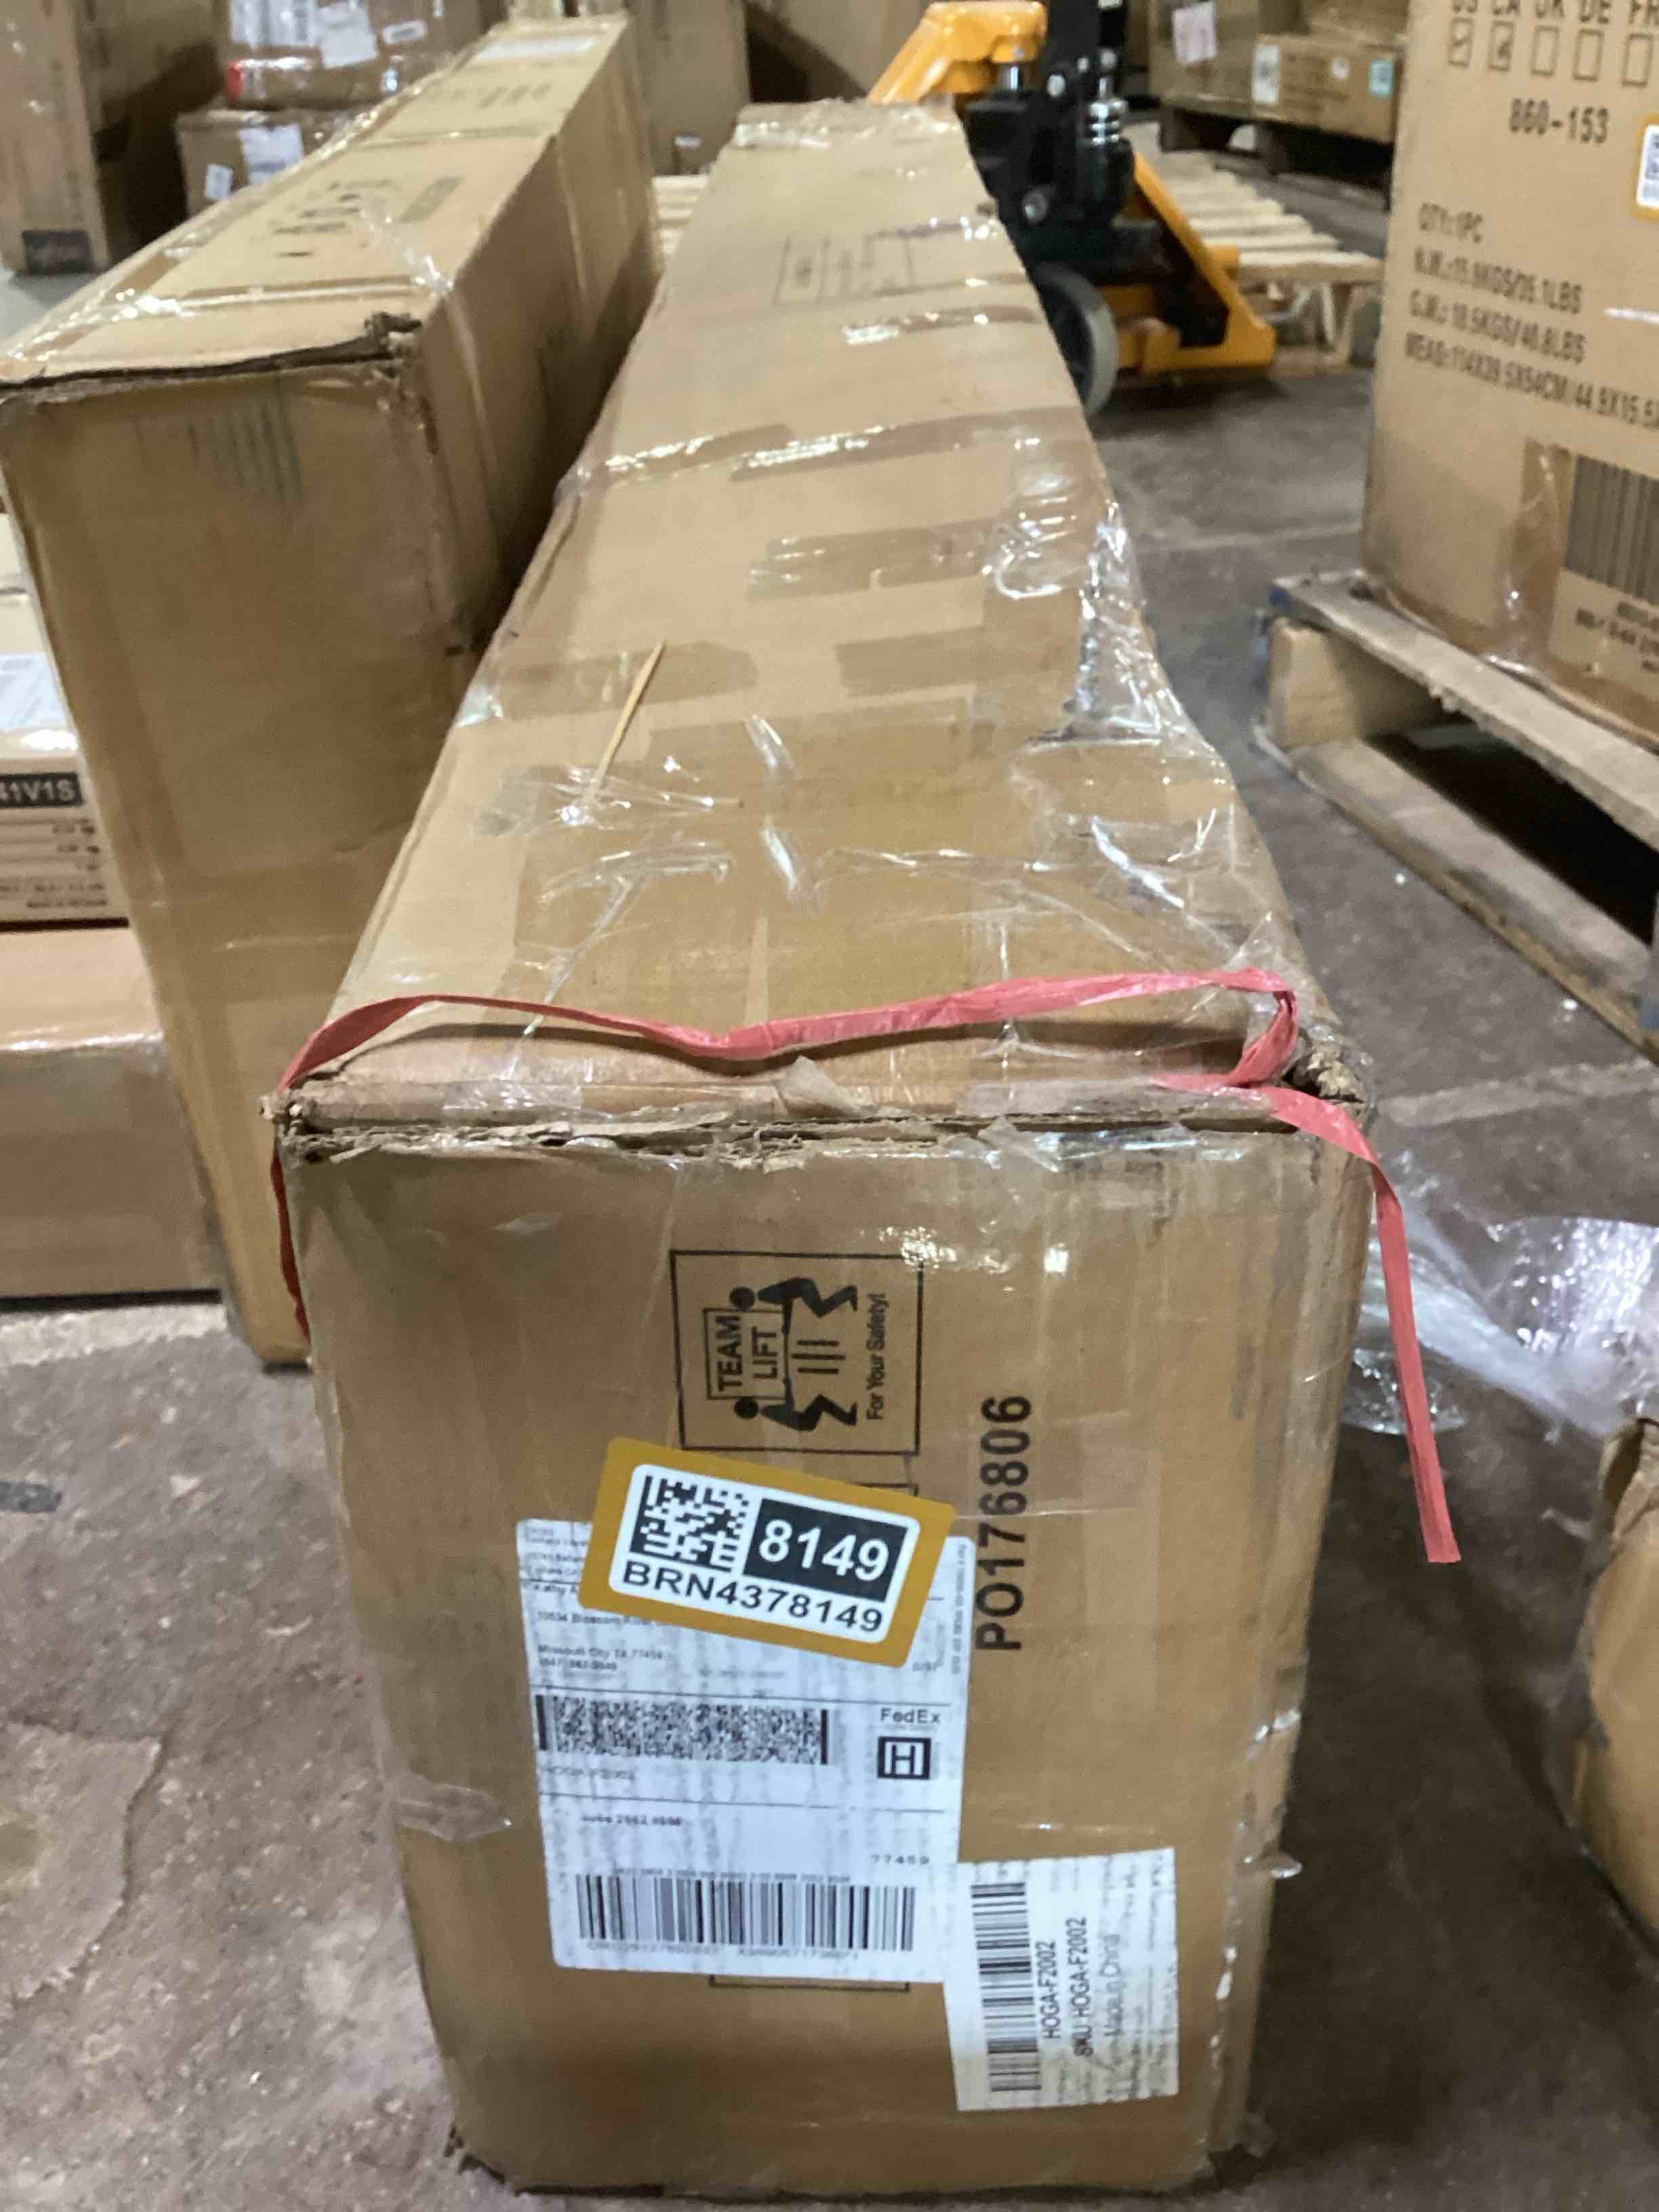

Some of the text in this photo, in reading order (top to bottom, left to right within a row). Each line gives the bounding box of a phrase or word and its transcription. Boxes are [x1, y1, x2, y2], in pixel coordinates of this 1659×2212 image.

[718, 1315, 744, 1391] TEAM
[752, 1326, 777, 1380] LIFT
[866, 1293, 889, 1420] For Your Safety!
[758, 1519, 890, 1582] 8149
[623, 1561, 883, 1633] BRN4378149
[880, 1708, 941, 1725] FedEx
[890, 1744, 916, 1774] H
[1034, 1941, 1062, 2039] HOGA-F2002
[1065, 1917, 1090, 2017] HOGA-F2002
